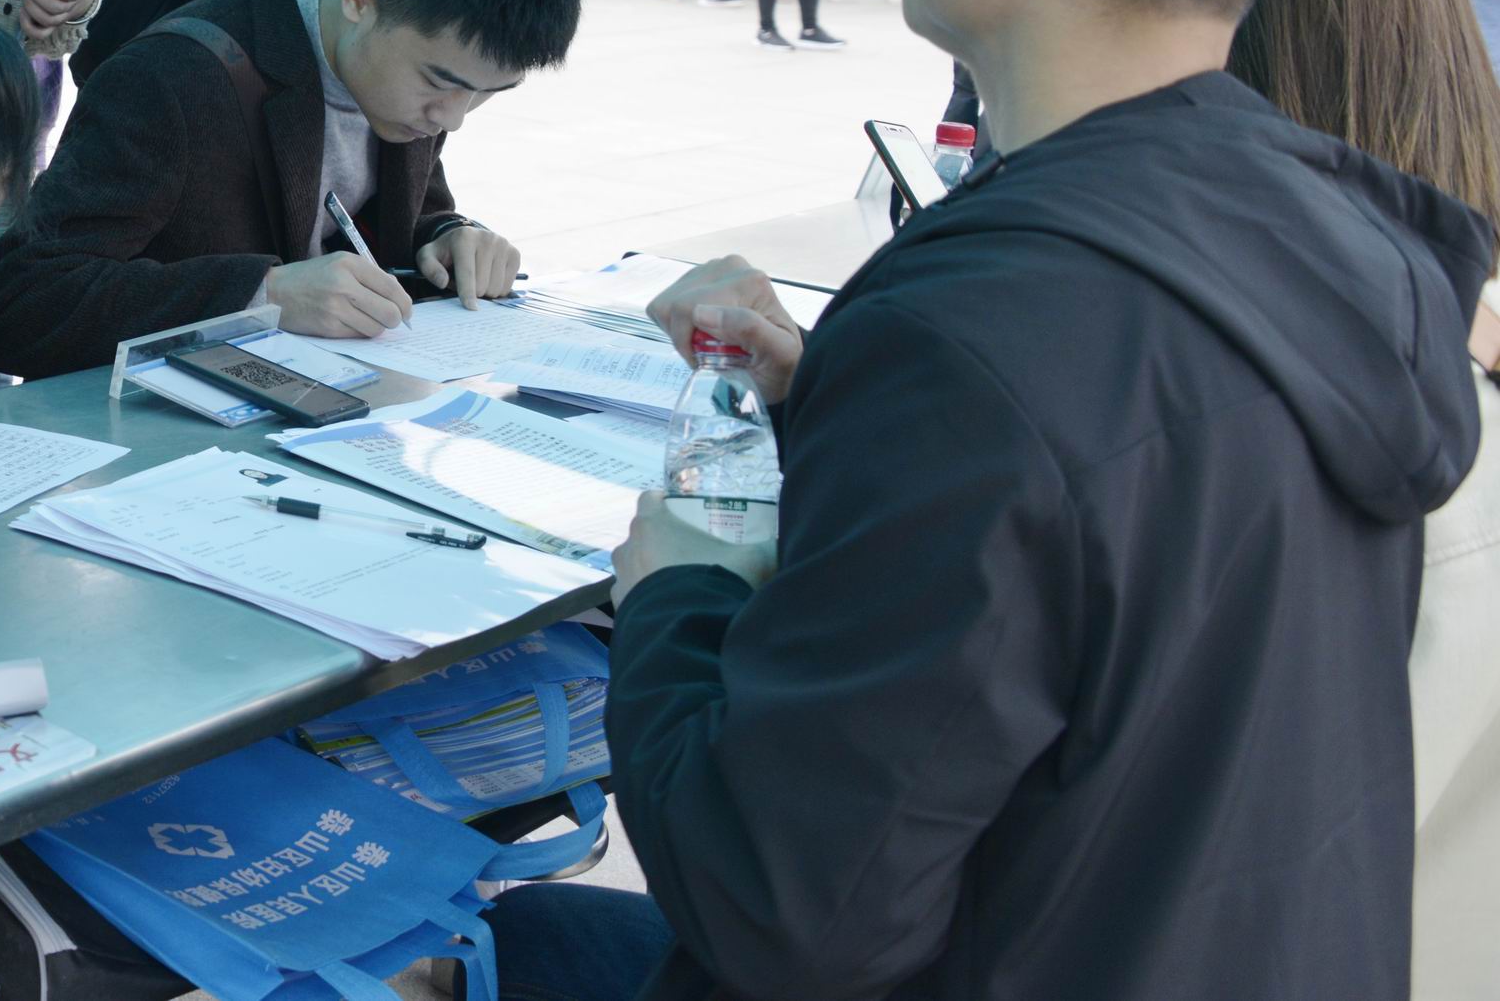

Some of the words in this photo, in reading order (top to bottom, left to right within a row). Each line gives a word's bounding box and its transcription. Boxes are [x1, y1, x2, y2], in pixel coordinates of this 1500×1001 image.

[221, 841, 390, 930] 泰山区人民医院
